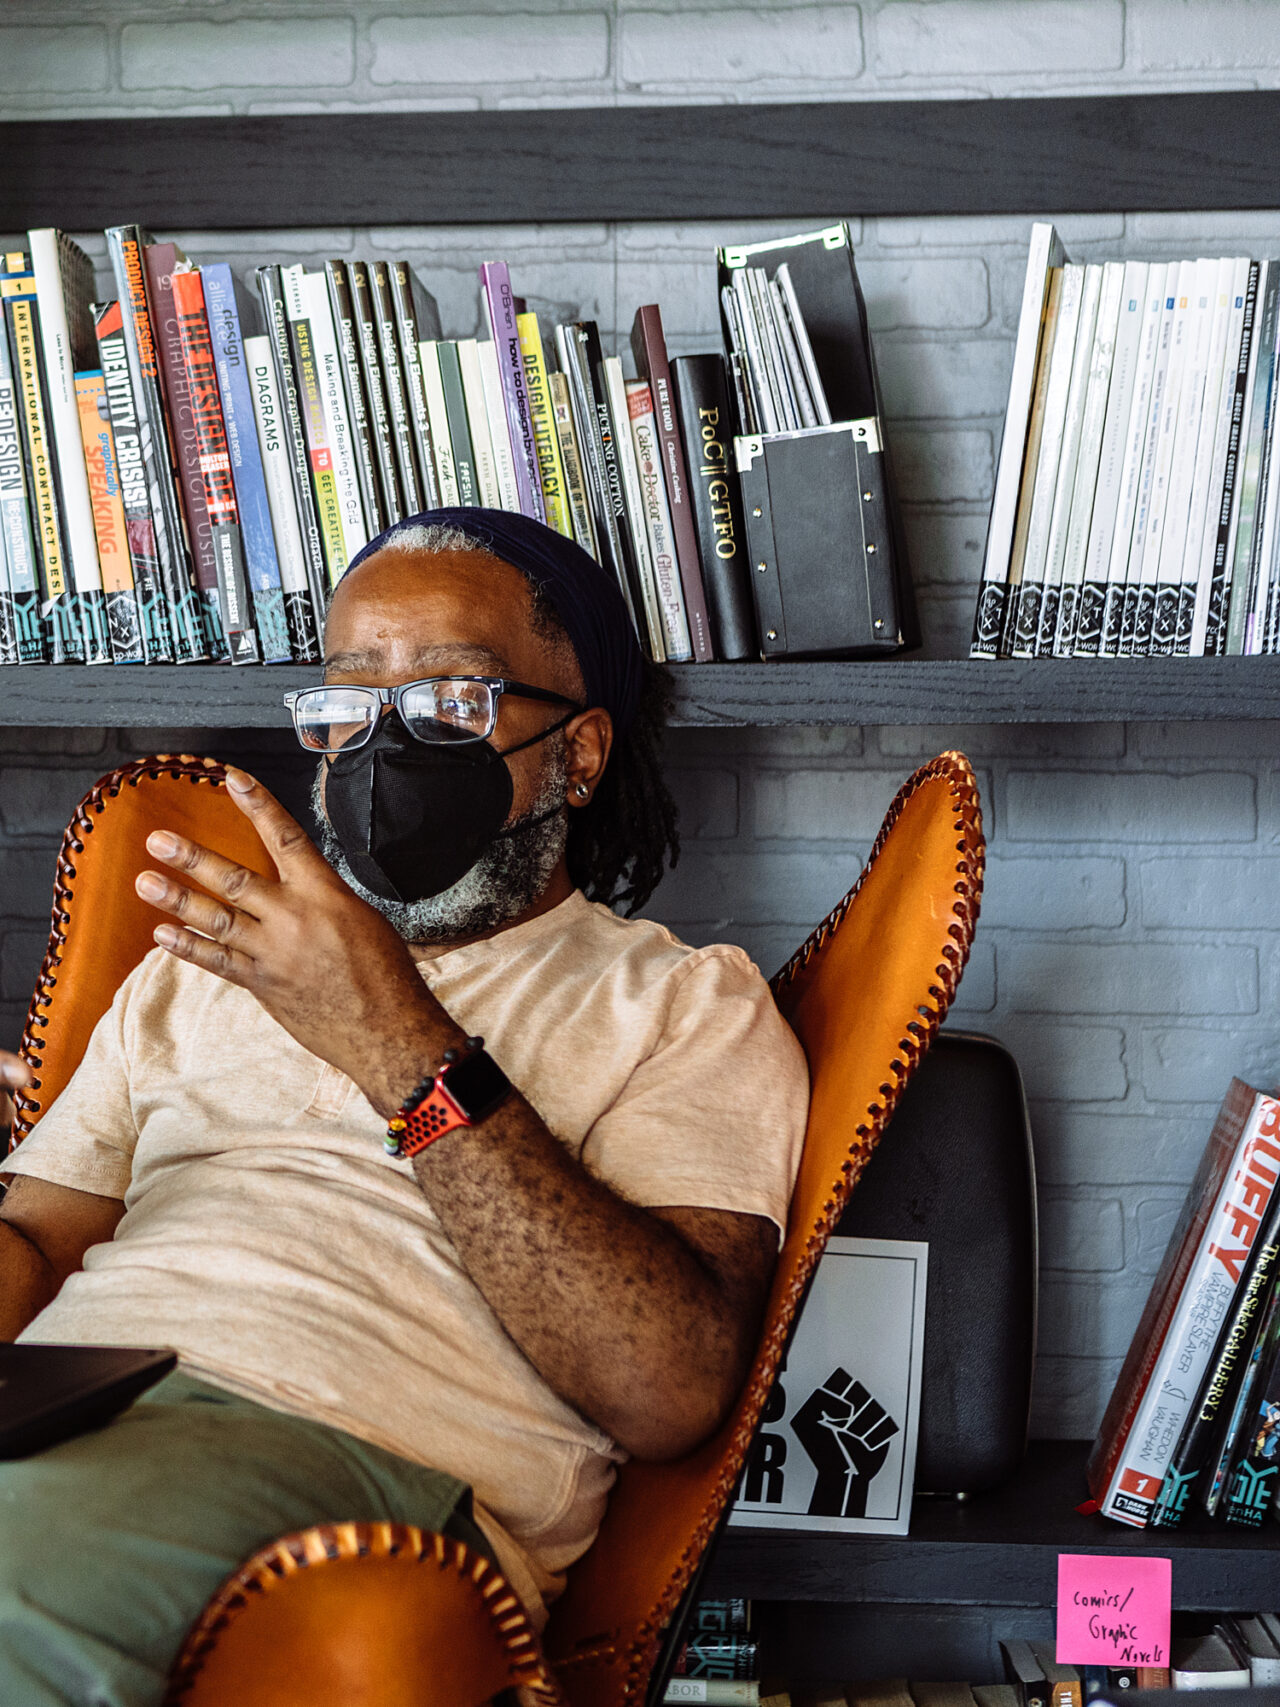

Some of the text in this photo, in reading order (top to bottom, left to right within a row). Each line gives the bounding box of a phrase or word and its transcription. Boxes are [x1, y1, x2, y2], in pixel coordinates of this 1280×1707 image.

[122, 240, 156, 365] PRODUCT DESIGN
[291, 272, 302, 314] PETERSON
[500, 283, 513, 330] O'Brien
[223, 308, 241, 368] design
[341, 319, 356, 364] Design
[403, 319, 418, 364] Design
[179, 307, 227, 456] THE DESIGN
[218, 360, 243, 468] UNITING WEB DESIGN
[254, 366, 280, 452] DIAGRAMS
[273, 299, 310, 498] Creativity Graphic Designers
[508, 338, 531, 437] how to design
[657, 378, 674, 432] PURE FOOD
[1221, 265, 1259, 526] BLACK MAGAZINE SINGLE IMAGE CONTEST AWARDS
[17, 304, 56, 546] INTERNATIONAL CONTRACT
[100, 338, 148, 509] IDENTITY CRISIS!
[164, 318, 216, 567] GRAPHIC DESIGN USA
[296, 323, 344, 553] USING DESIGN BASICS TO GET CREATIVE
[323, 353, 360, 526] Making and Breaking the Grid
[522, 354, 544, 417] DESIGN
[534, 419, 561, 498] LITERACY
[635, 424, 653, 462] Cake
[97, 432, 117, 497] graphically
[438, 446, 454, 482] Fresh
[564, 450, 581, 493] HANDBOOK
[597, 403, 615, 462] PICKING
[606, 464, 625, 517] COTTON
[85, 445, 118, 555] SPEAKING
[642, 473, 662, 522] Doctor
[652, 524, 667, 554] Bakes
[227, 594, 240, 625] DISSENT
[656, 554, 680, 634] Gluten-Free
[1208, 1095, 1280, 1285] BUFFY
[1178, 1271, 1224, 1374] VAMPIRE SLAYER
[1200, 1243, 1280, 1422] The Far 3
[1201, 1325, 1219, 1354] THE
[1140, 1406, 1168, 1461] VAUGHAN
[1154, 1412, 1181, 1464] WHEDON
[1135, 1478, 1149, 1493] 1
[1088, 1614, 1139, 1649] Graphic
[1120, 1644, 1163, 1664] Novels
